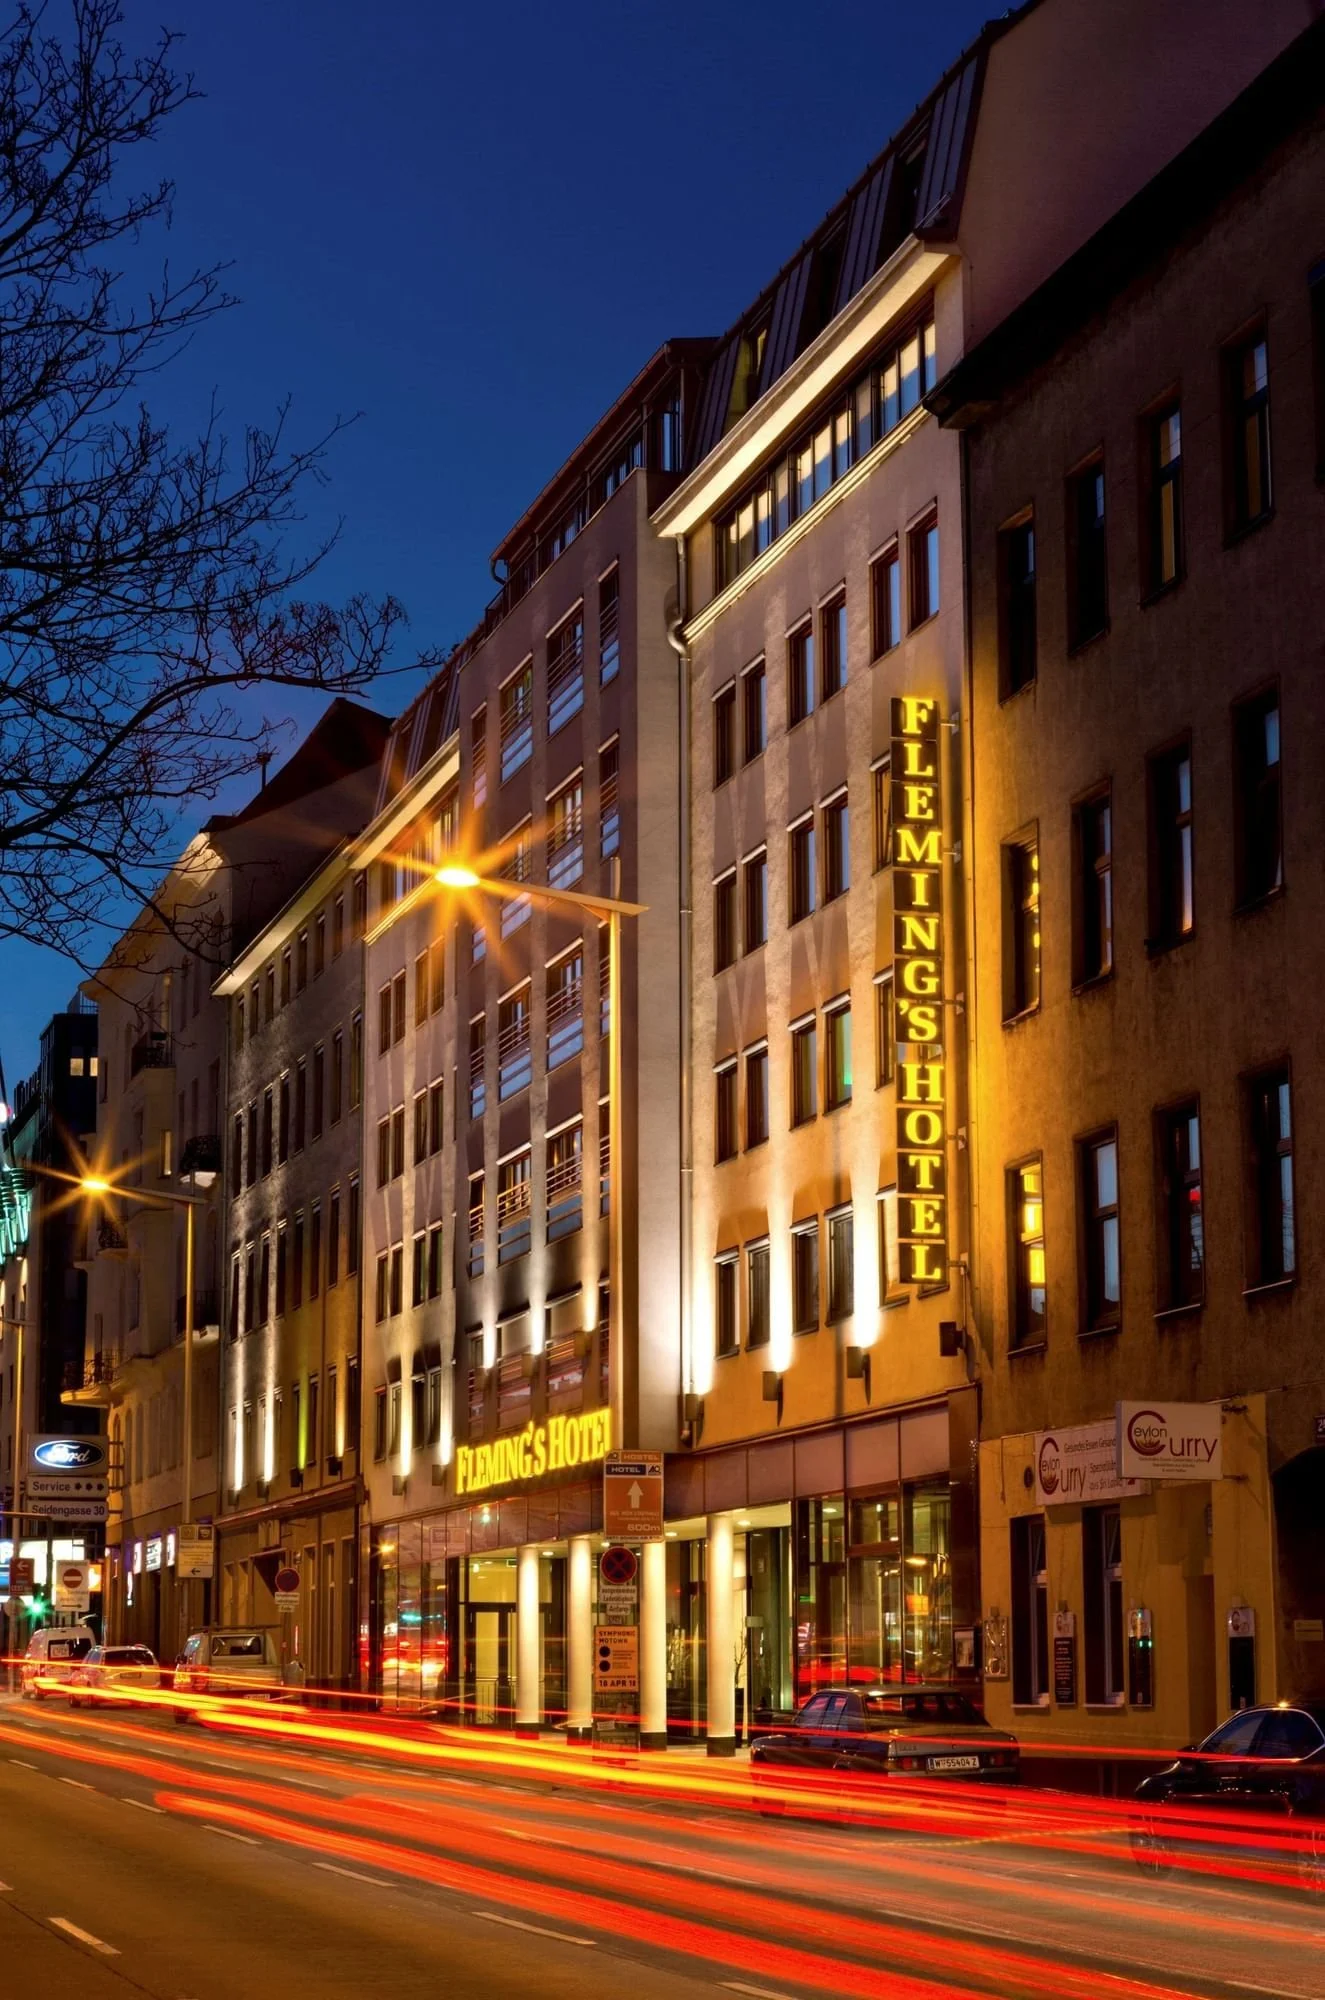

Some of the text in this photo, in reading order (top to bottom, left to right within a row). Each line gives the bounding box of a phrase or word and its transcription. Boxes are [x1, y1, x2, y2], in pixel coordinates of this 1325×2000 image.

[897, 697, 944, 1281] FLEMING'S HOTEL
[47, 1443, 90, 1463] Ford
[456, 1421, 545, 1494] FLEMING'S
[623, 1453, 659, 1461] HOSTEL
[32, 1481, 71, 1491] Service
[32, 1504, 105, 1518] Seidengasse 30
[610, 1679, 627, 1687] APR
